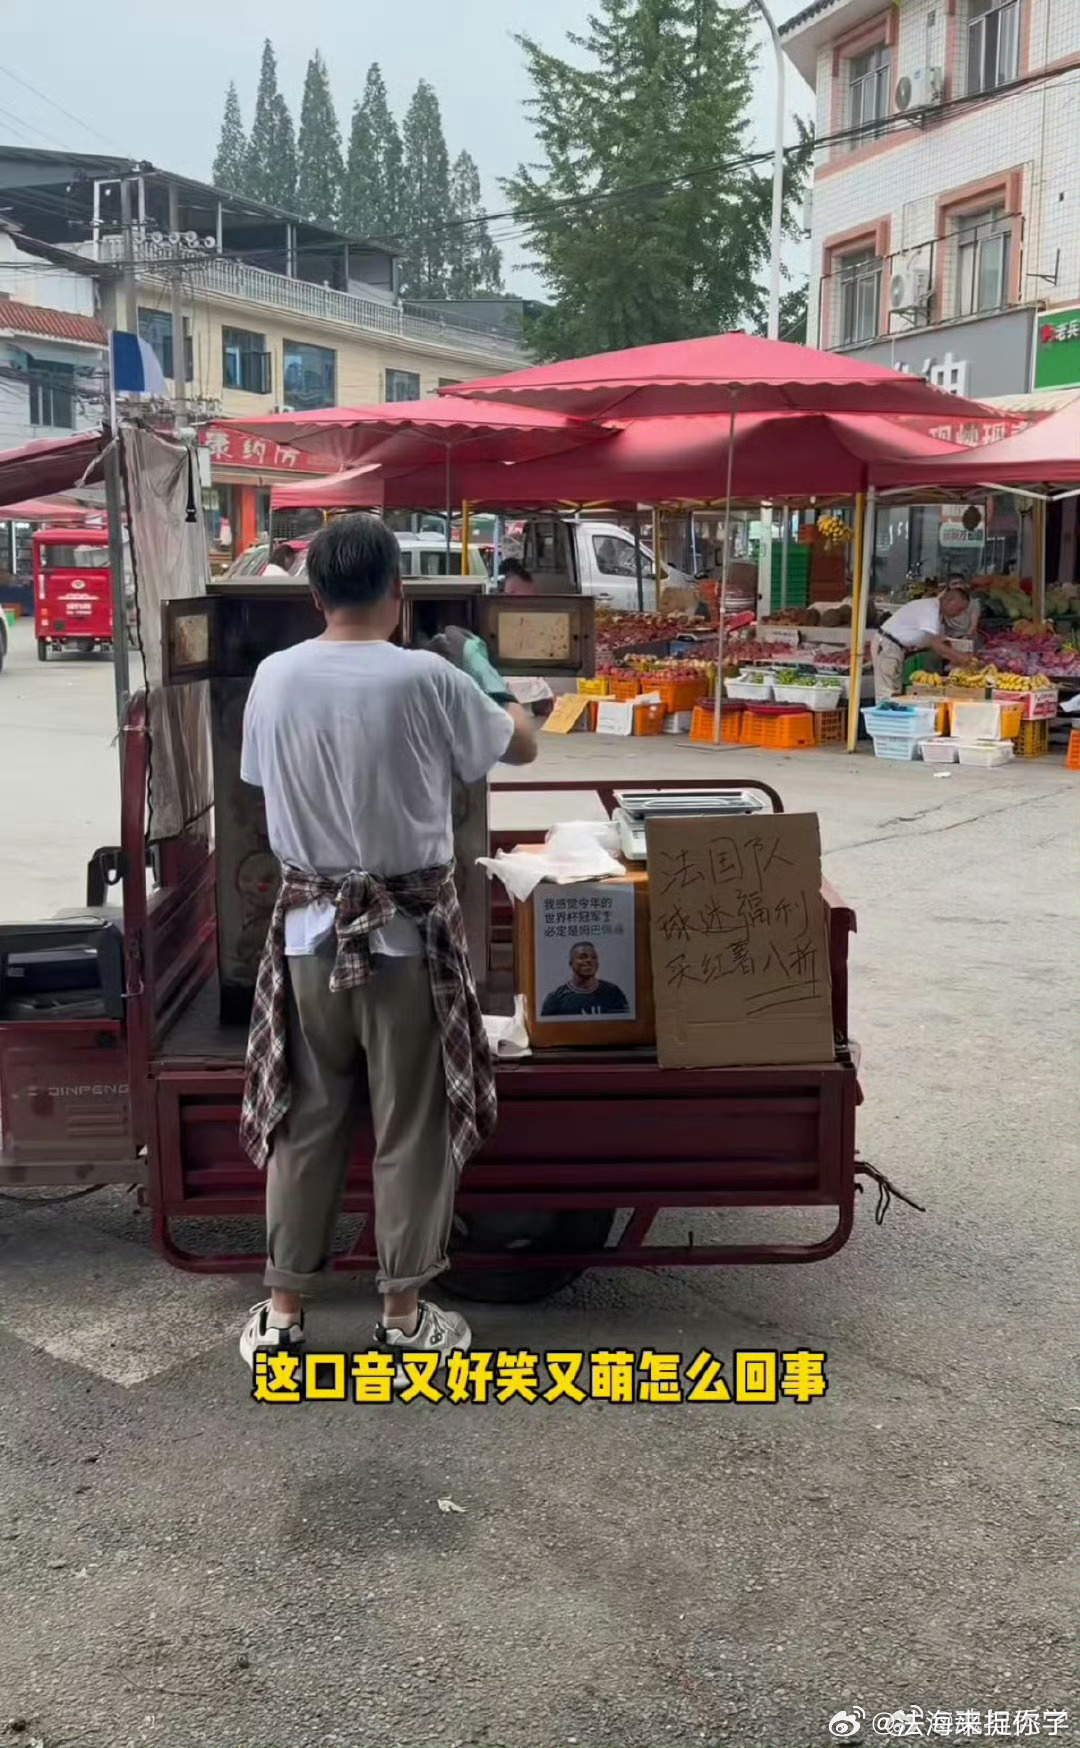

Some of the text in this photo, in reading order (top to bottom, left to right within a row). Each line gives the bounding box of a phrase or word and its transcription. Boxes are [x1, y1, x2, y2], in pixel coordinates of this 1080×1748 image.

[660, 836, 795, 894] 法国队
[544, 897, 613, 910] 我感觉今年的
[665, 940, 819, 997] 买红薯八折
